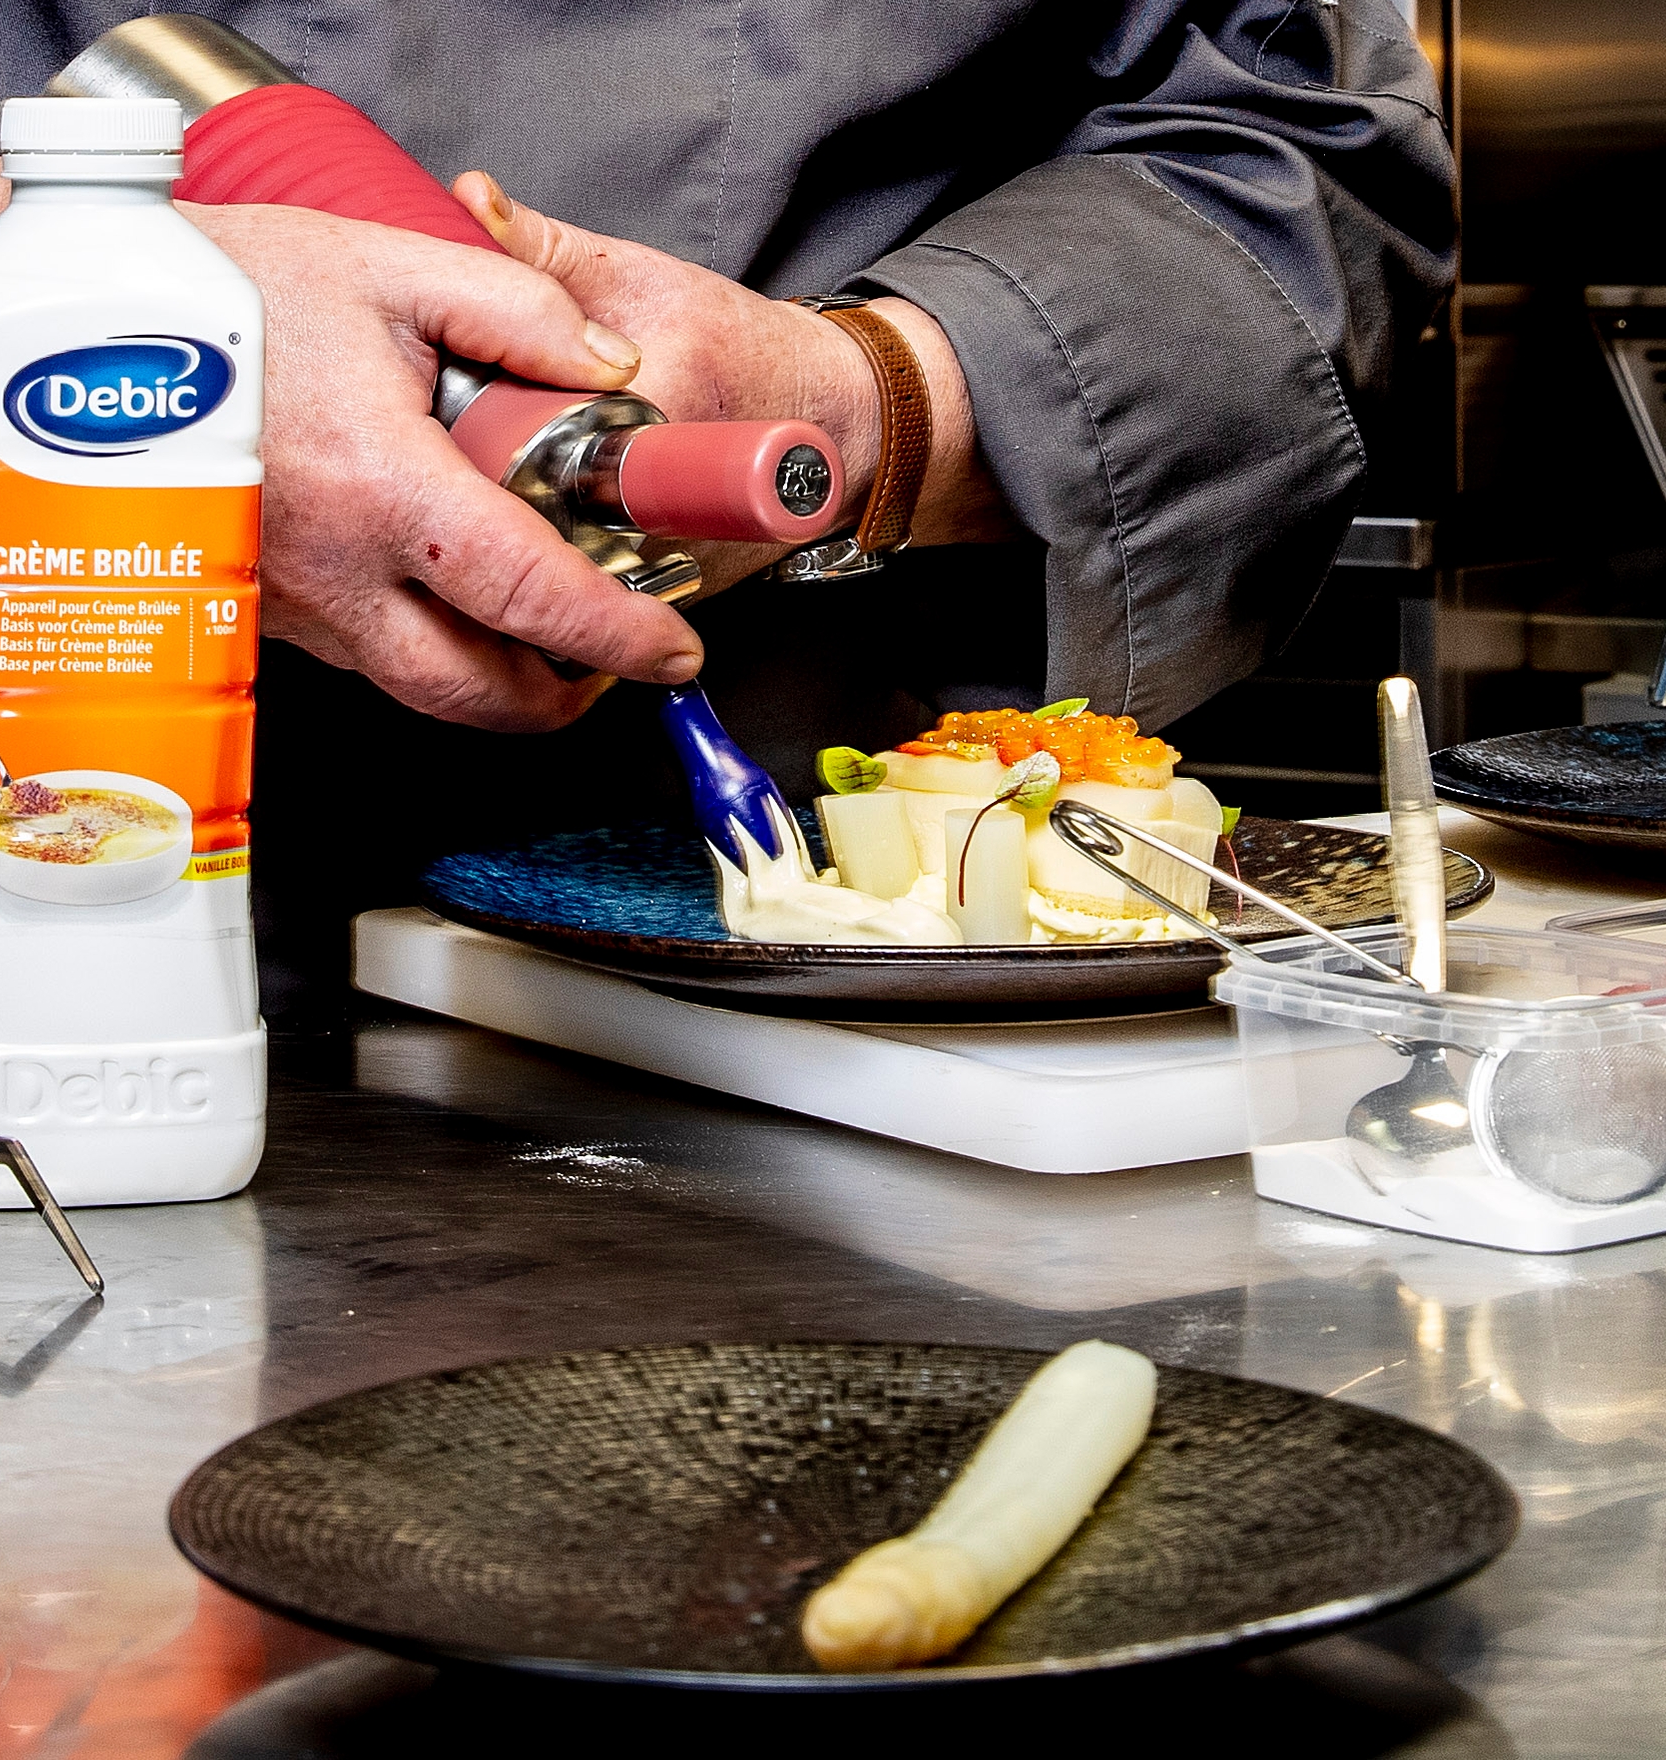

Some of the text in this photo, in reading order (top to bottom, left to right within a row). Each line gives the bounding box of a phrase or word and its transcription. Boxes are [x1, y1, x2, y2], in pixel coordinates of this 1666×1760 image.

[48, 374, 197, 418] Debic
[94, 542, 203, 577] BRÛLÉE
[1, 598, 181, 618] Appareil pour Crème Brûlée
[205, 599, 238, 624] 10
[0, 617, 163, 635] Basis voor Crème Brûlée
[205, 626, 212, 636] x
[0, 636, 153, 655] Basis für Crème Brûlée
[33, 659, 56, 675] per
[59, 657, 103, 673] Crème
[107, 657, 153, 674] Brûlée
[195, 857, 231, 874] VANILLE
[3, 1056, 211, 1126] Debic
